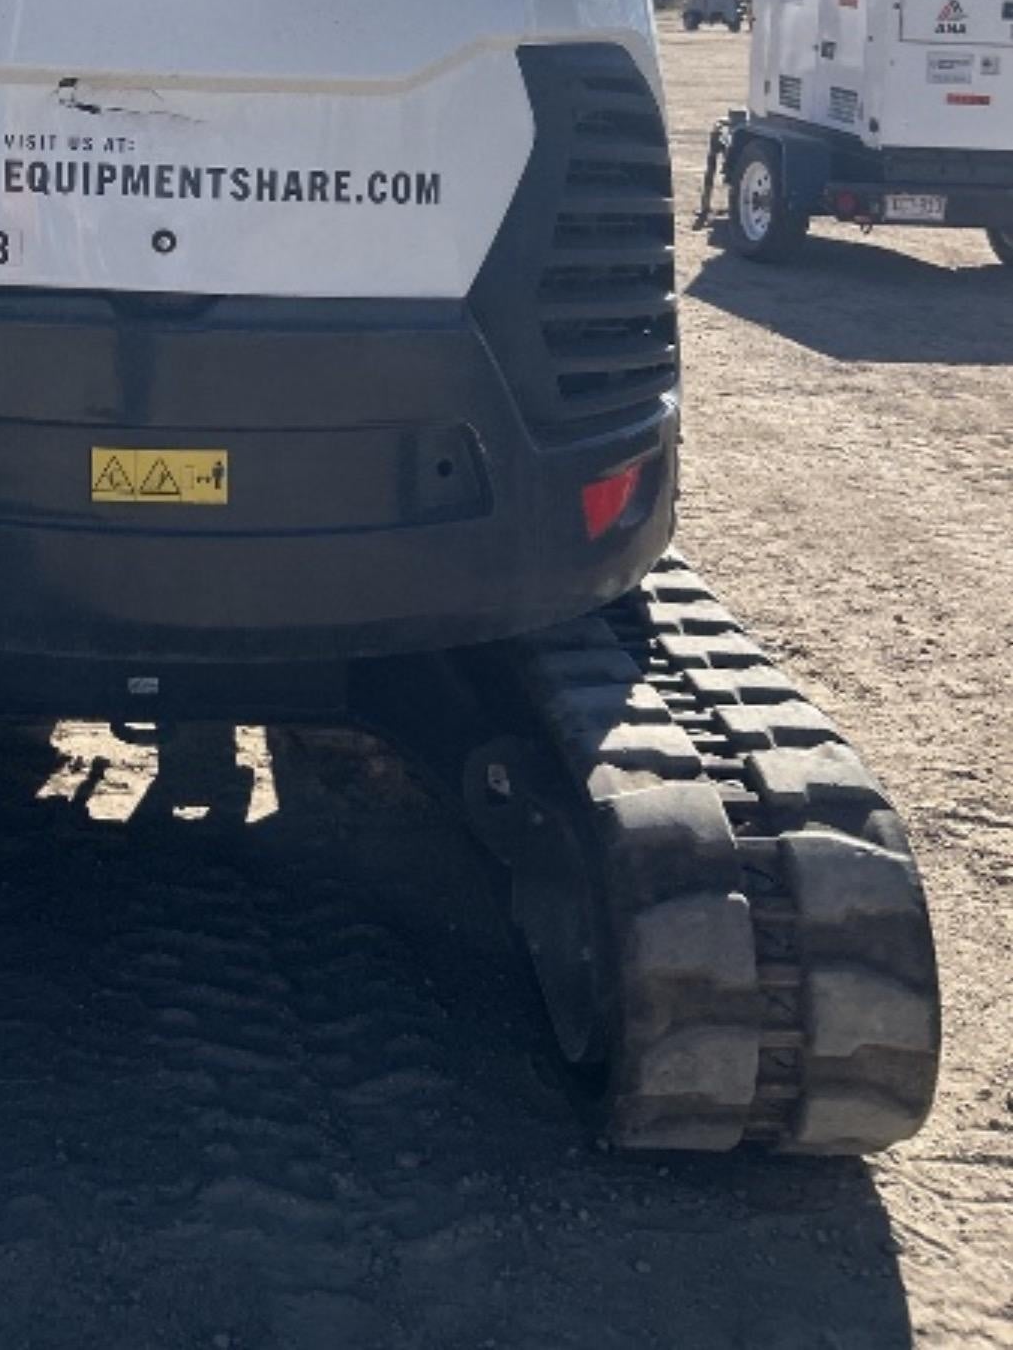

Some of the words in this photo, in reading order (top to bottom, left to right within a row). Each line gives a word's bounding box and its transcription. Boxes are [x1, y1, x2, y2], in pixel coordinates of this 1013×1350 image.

[4, 134, 57, 151] VISIT
[68, 136, 93, 152] US
[103, 137, 135, 154] AT:
[4, 159, 441, 205] EQUIPMENTSHARE.COM
